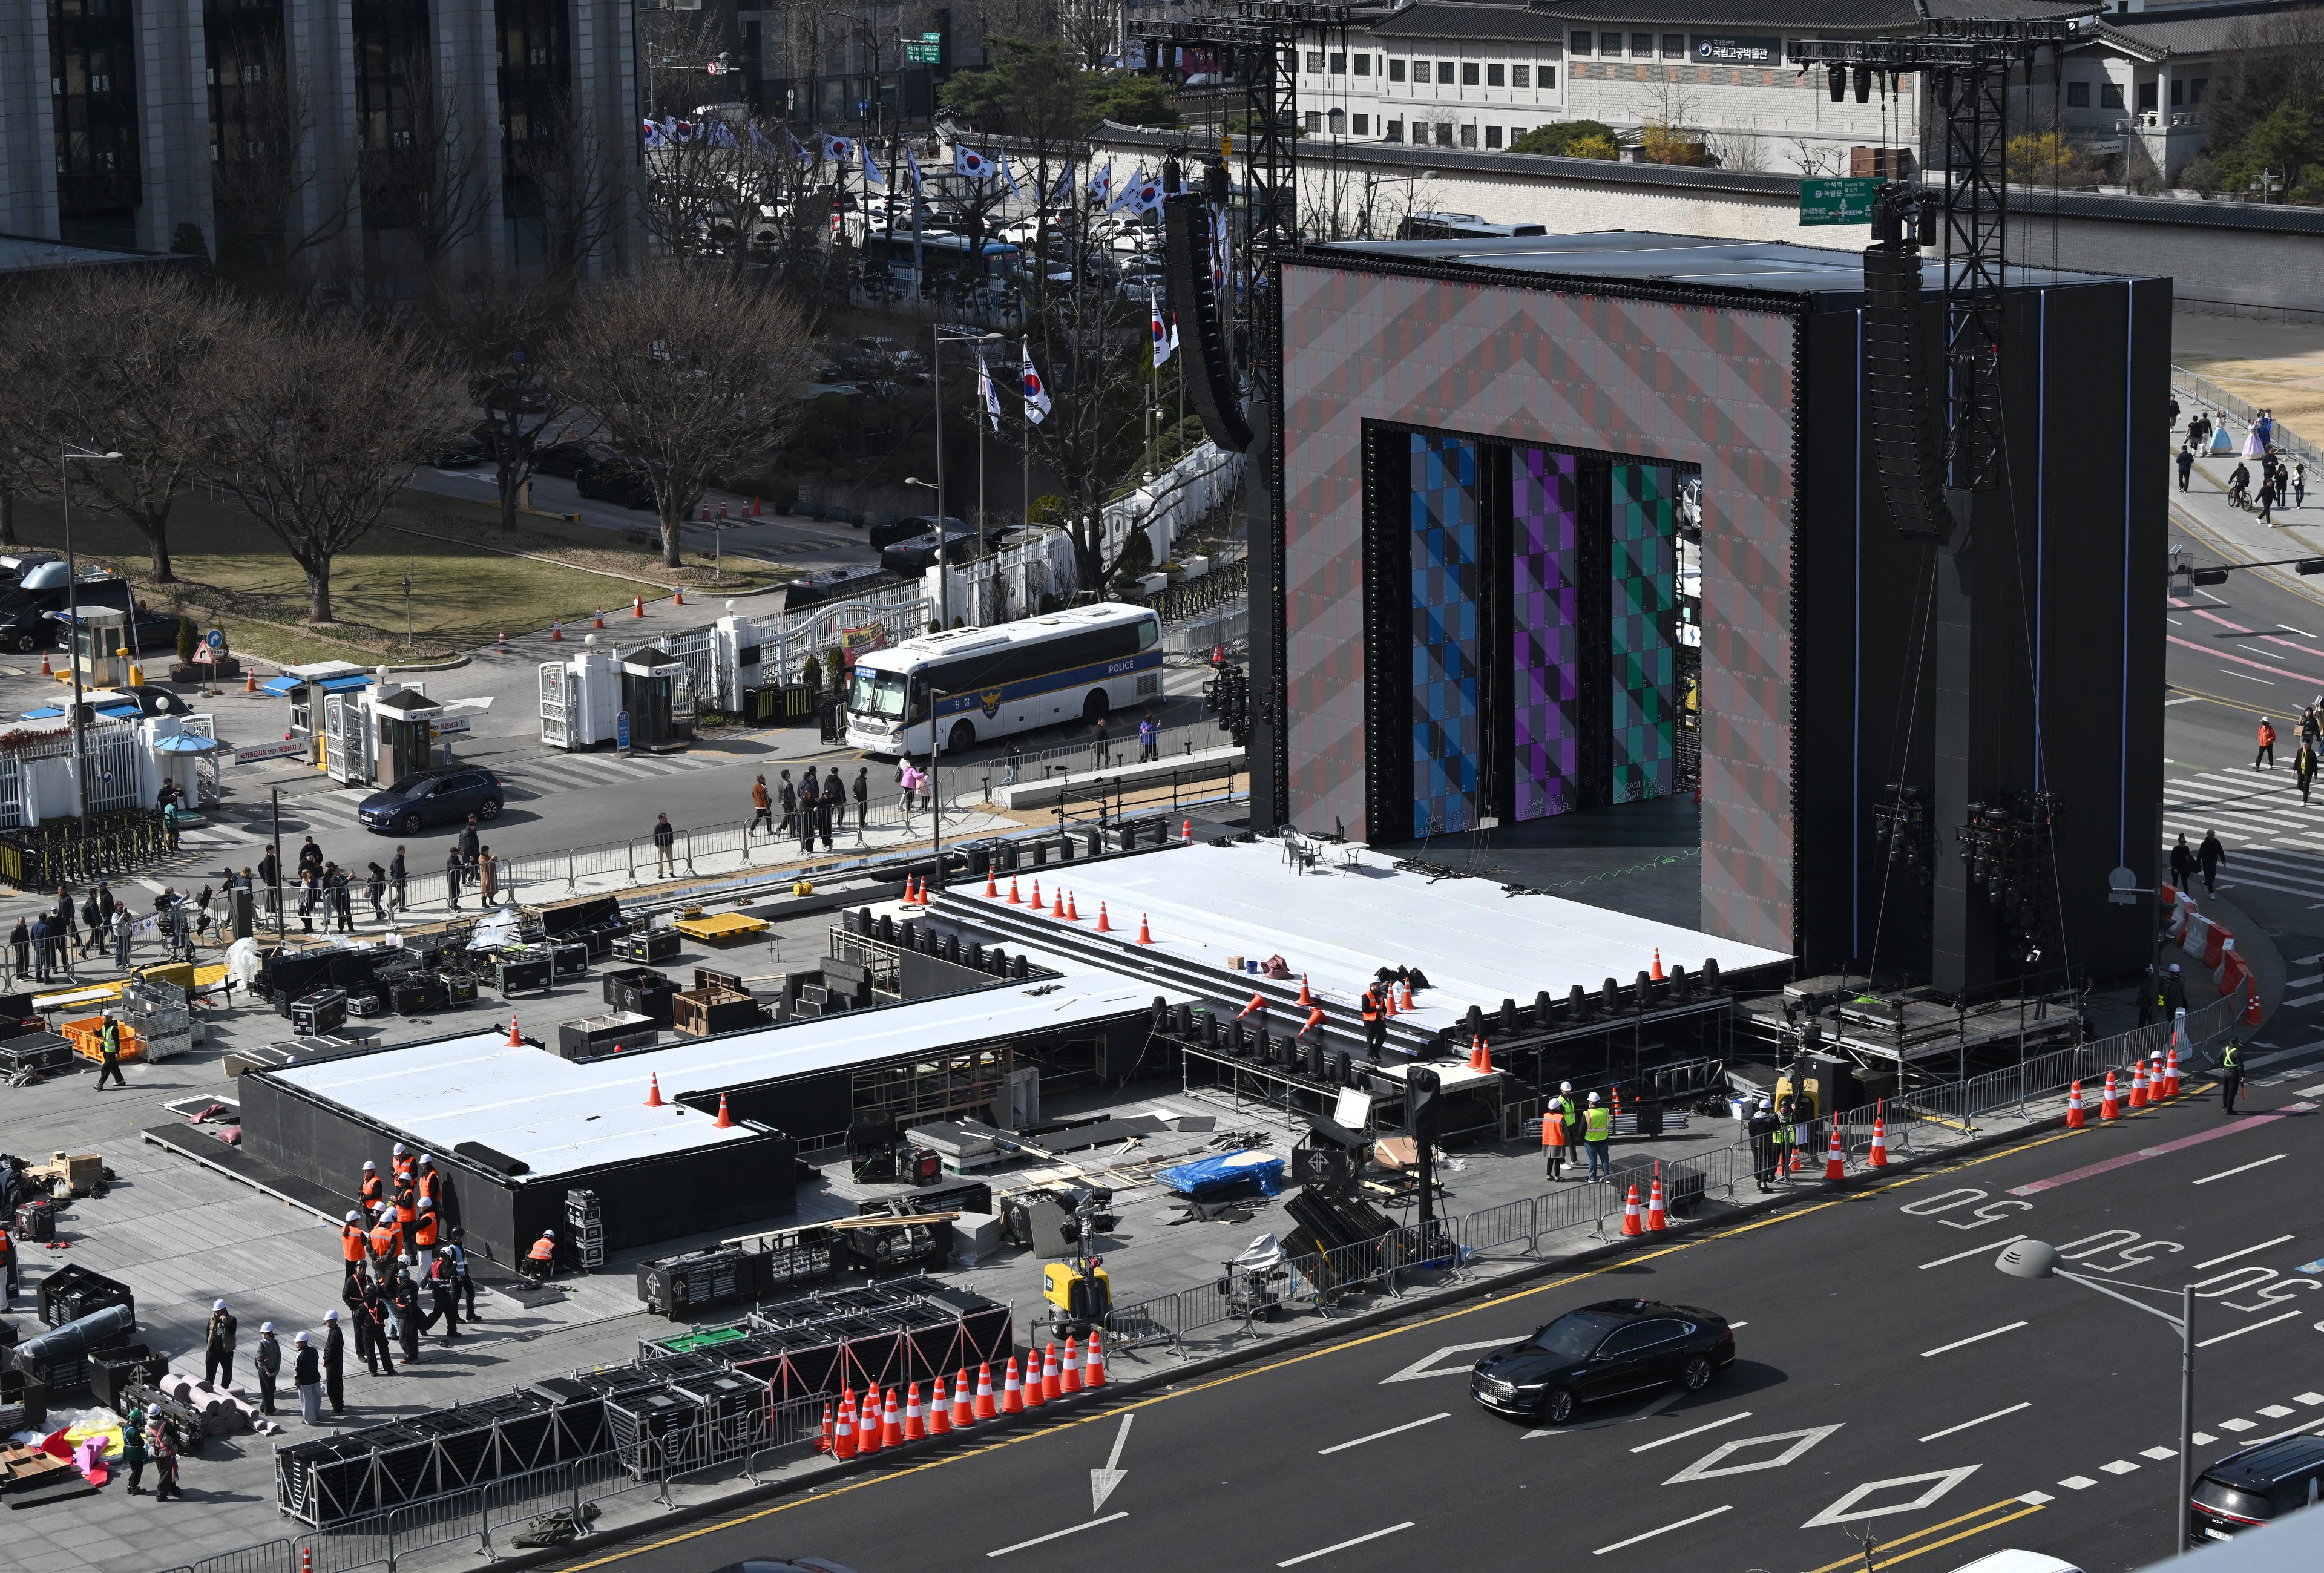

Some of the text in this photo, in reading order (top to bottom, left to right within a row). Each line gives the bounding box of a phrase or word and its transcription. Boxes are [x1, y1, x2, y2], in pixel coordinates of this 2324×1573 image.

[1713, 47, 1768, 59] 국립고궁박물관
[1109, 660, 1134, 674] POLICE
[954, 700, 960, 709] 경
[964, 697, 970, 707] 찰
[440, 721, 458, 730] 통행금지
[240, 749, 267, 759] 국가중요시설
[278, 744, 297, 753] 통행금지
[1623, 777, 1662, 791] CAM LEFT
[1526, 793, 1566, 807] CAM LEFT
[1617, 785, 1668, 801] STAGE LEVEL
[1520, 802, 1572, 818] STAGE LEVEL
[1426, 811, 1466, 824] CAM LEFT
[1419, 819, 1472, 835] STAGE LEVEL
[1900, 1188, 2034, 1230] 50
[2054, 1229, 2184, 1273] 50
[2183, 1267, 2322, 1312] 50
[651, 1296, 662, 1305] STORAGE
